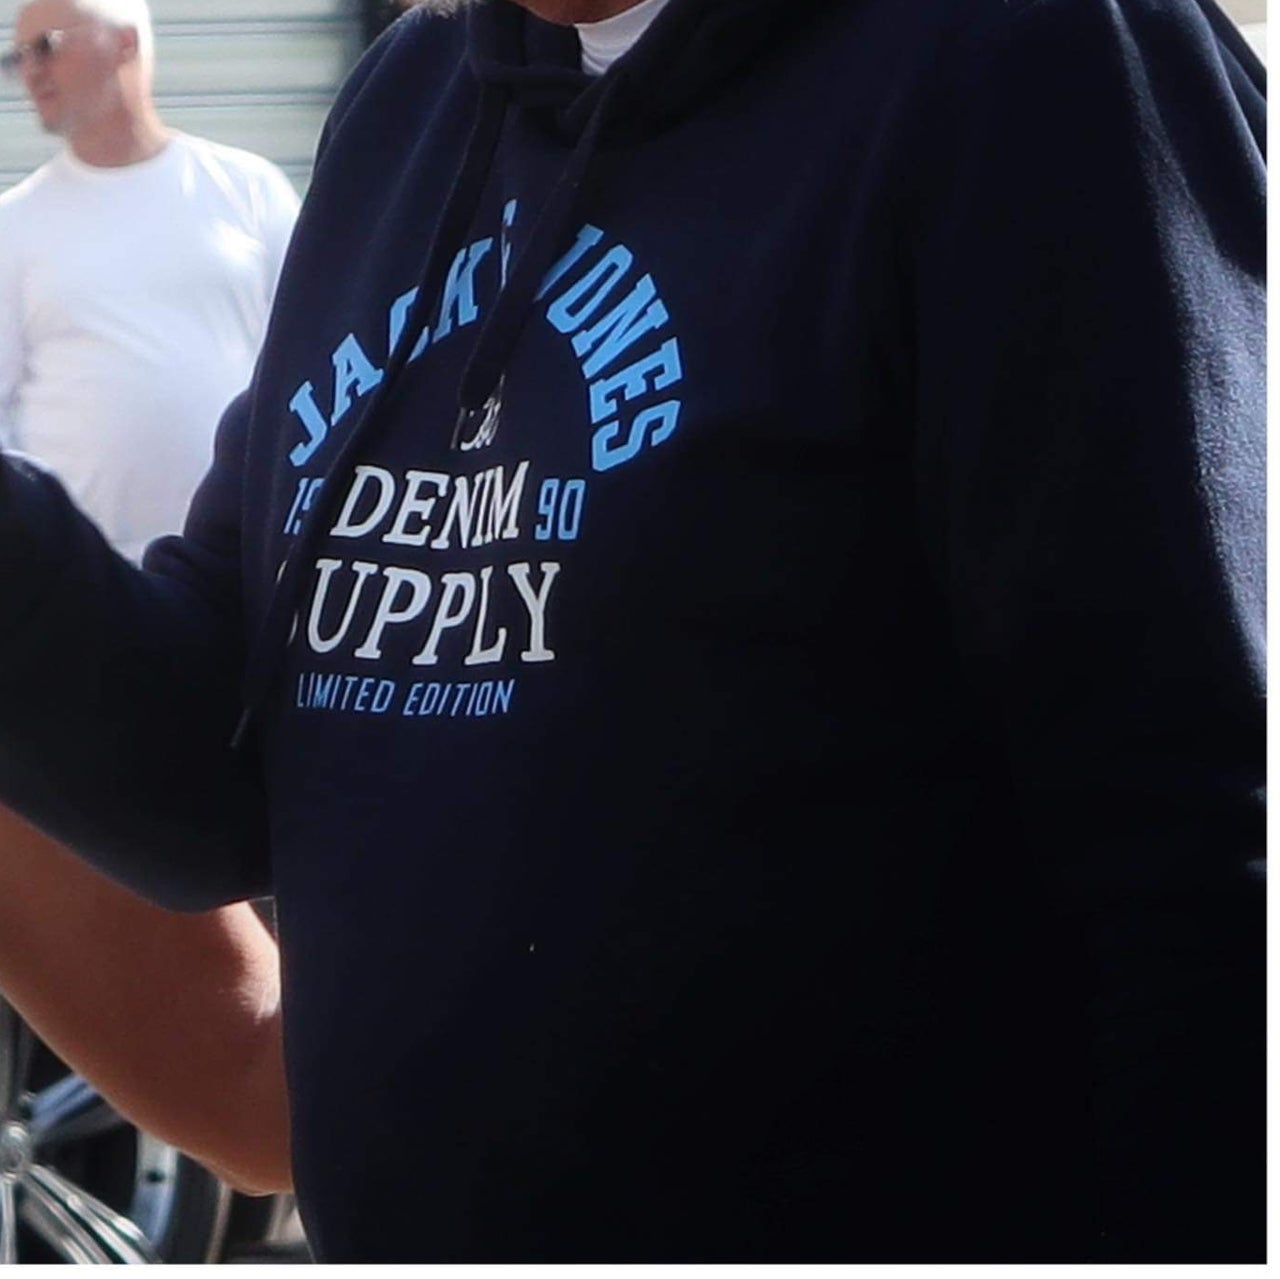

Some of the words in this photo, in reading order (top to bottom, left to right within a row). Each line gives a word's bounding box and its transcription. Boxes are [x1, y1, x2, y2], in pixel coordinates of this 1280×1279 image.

[287, 236, 494, 467] JACK
[329, 460, 530, 550] DENIM
[535, 478, 586, 540] 90
[278, 558, 561, 665] UPPLY
[296, 672, 395, 714] LIMITED
[403, 678, 516, 717] EDITION
